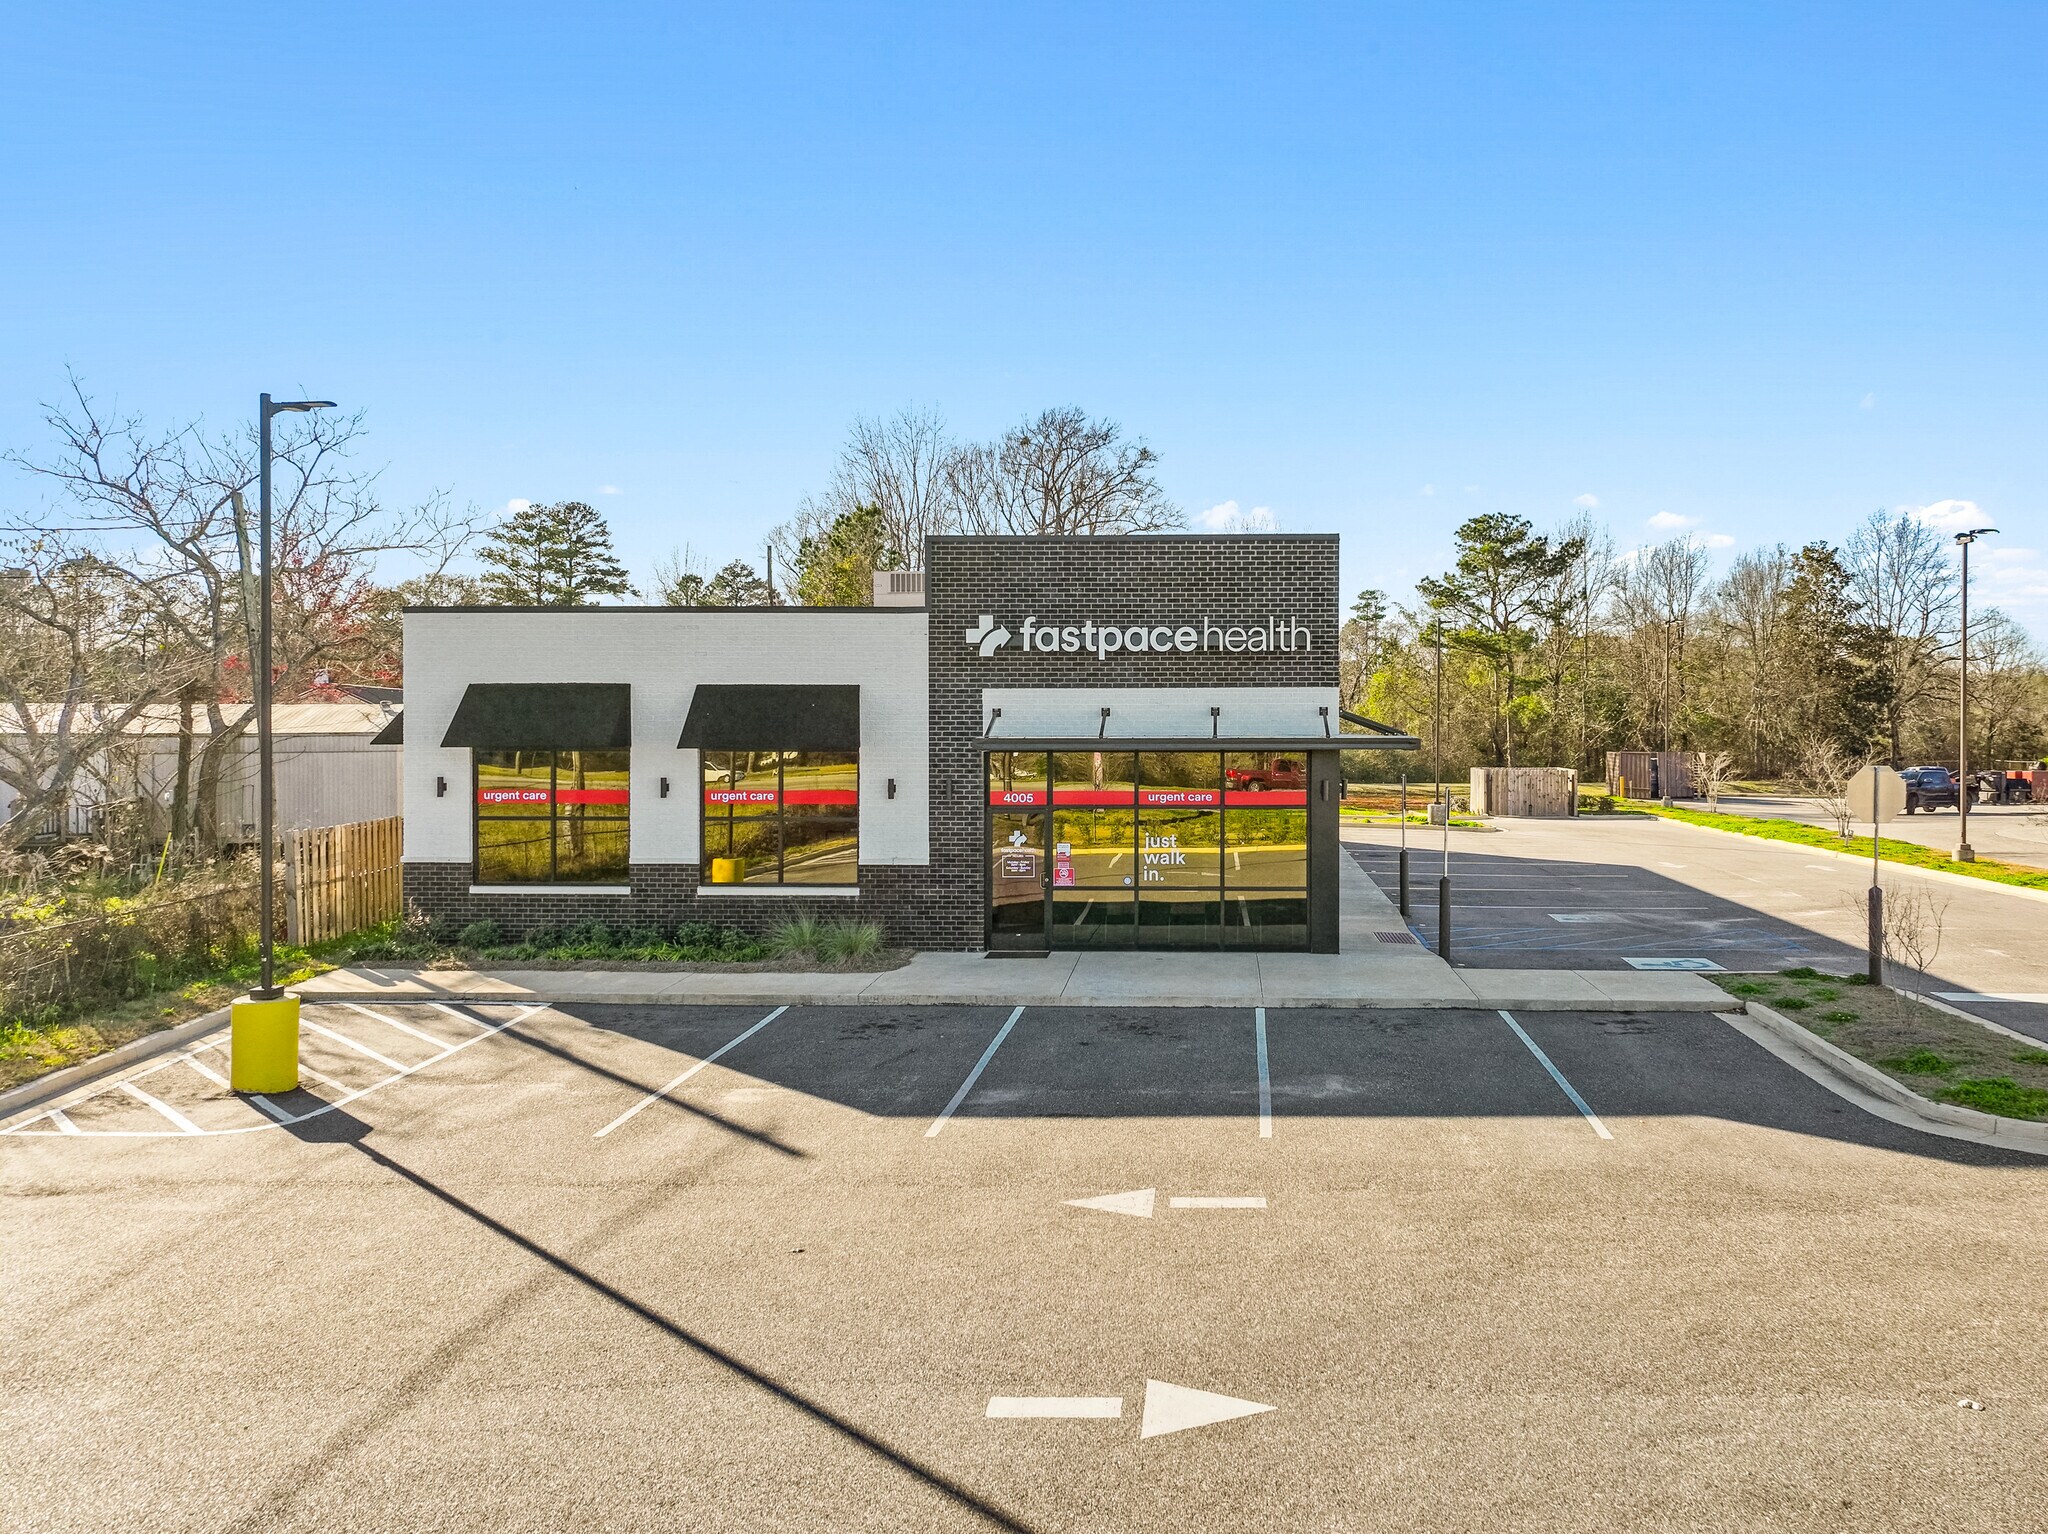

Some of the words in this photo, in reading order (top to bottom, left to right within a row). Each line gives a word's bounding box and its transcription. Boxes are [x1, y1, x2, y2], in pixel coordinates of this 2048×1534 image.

[1019, 615, 1311, 660] fastpacehealth
[483, 791, 520, 802] urgent
[522, 792, 547, 800] care
[710, 791, 747, 803] urgent
[749, 792, 774, 801] care
[1003, 793, 1034, 803] 4005
[1148, 792, 1185, 804] urgent
[1188, 793, 1213, 801] care
[1144, 832, 1177, 851] just
[1144, 850, 1186, 865] walk
[1143, 865, 1165, 881] in.
